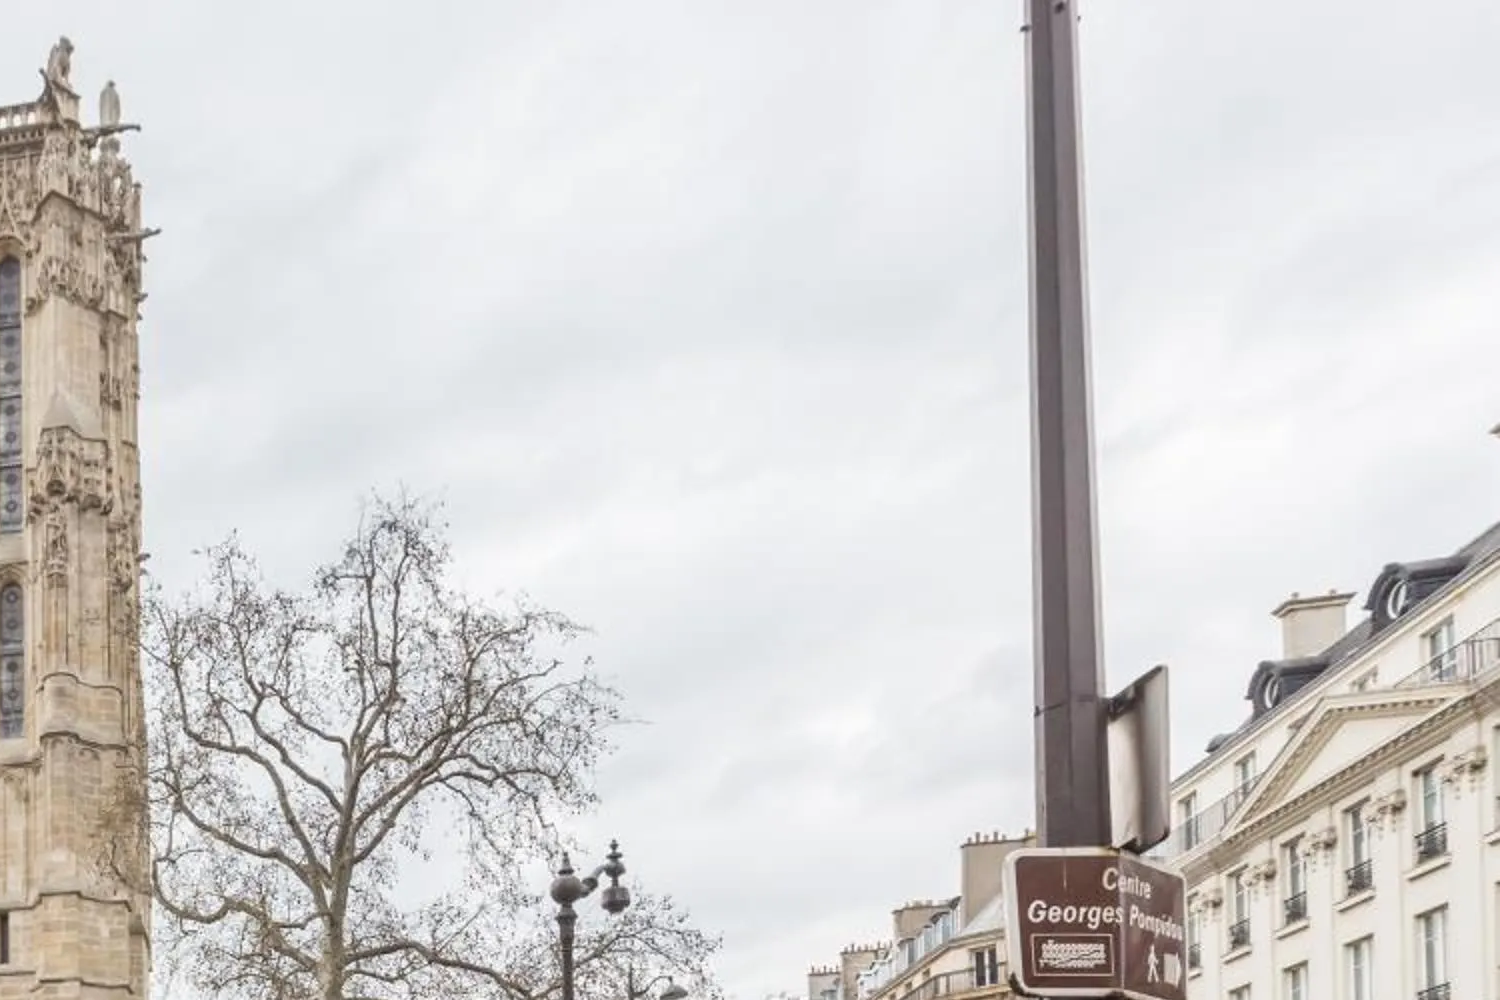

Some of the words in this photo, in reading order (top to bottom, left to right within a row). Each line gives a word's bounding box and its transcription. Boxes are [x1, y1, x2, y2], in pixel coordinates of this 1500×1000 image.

[1103, 867, 1152, 898] Centre
[1028, 900, 1124, 929] Georges
[1129, 904, 1183, 941] Pompidou
